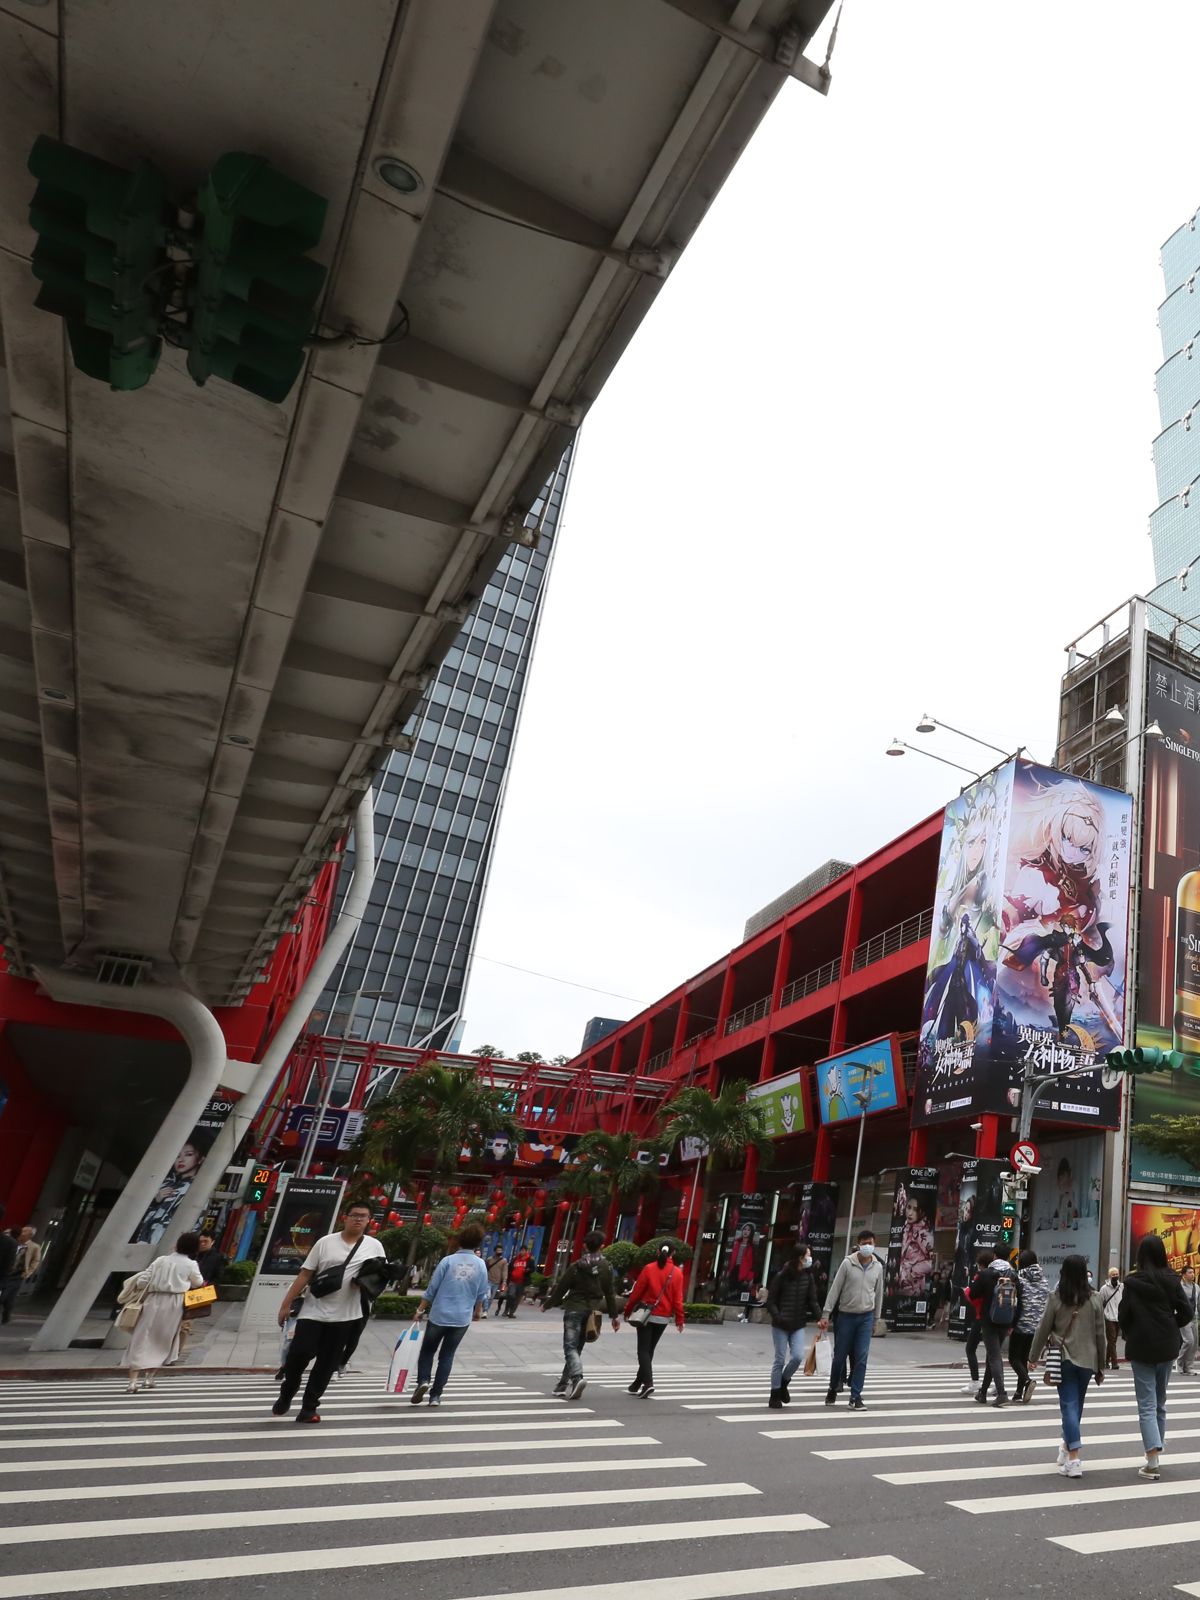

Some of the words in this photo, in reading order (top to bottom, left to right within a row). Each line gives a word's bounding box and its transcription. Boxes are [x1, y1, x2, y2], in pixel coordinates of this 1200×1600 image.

[1017, 1025, 1053, 1047] 異世界
[212, 1102, 233, 1111] BOY
[254, 1170, 269, 1183] 20
[1003, 1217, 1013, 1228] 20
